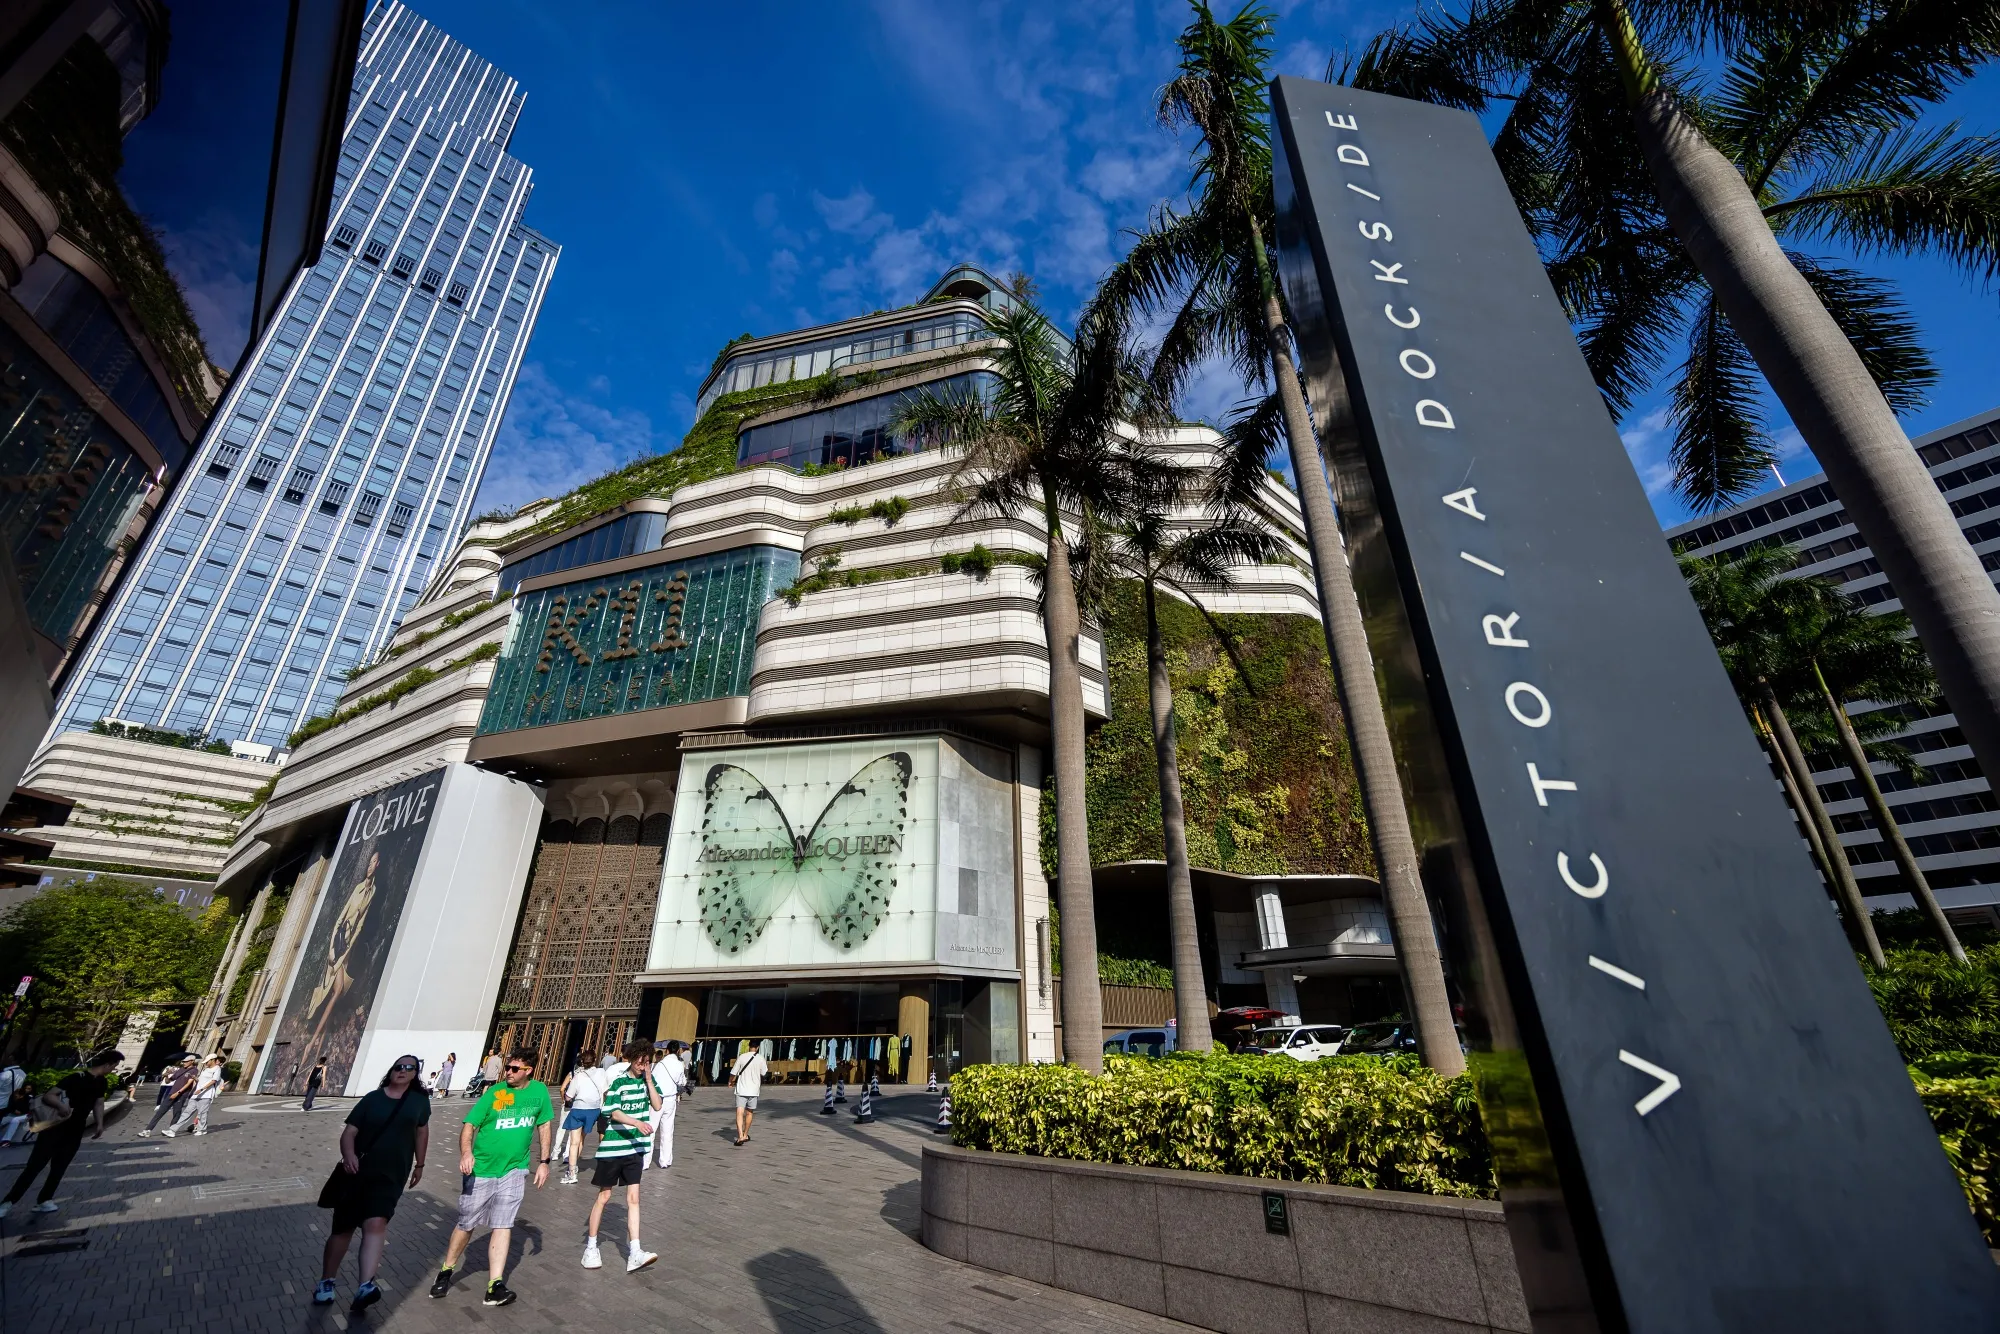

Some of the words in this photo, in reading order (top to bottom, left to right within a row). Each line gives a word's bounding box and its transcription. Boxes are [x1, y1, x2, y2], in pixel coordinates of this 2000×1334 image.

[536, 570, 689, 674] K11
[525, 670, 676, 718] MUSEA
[349, 783, 435, 846] LOEWE
[695, 840, 793, 863] Alexander
[793, 833, 906, 863] McQUEEN
[494, 1116, 535, 1130] IRELAND
